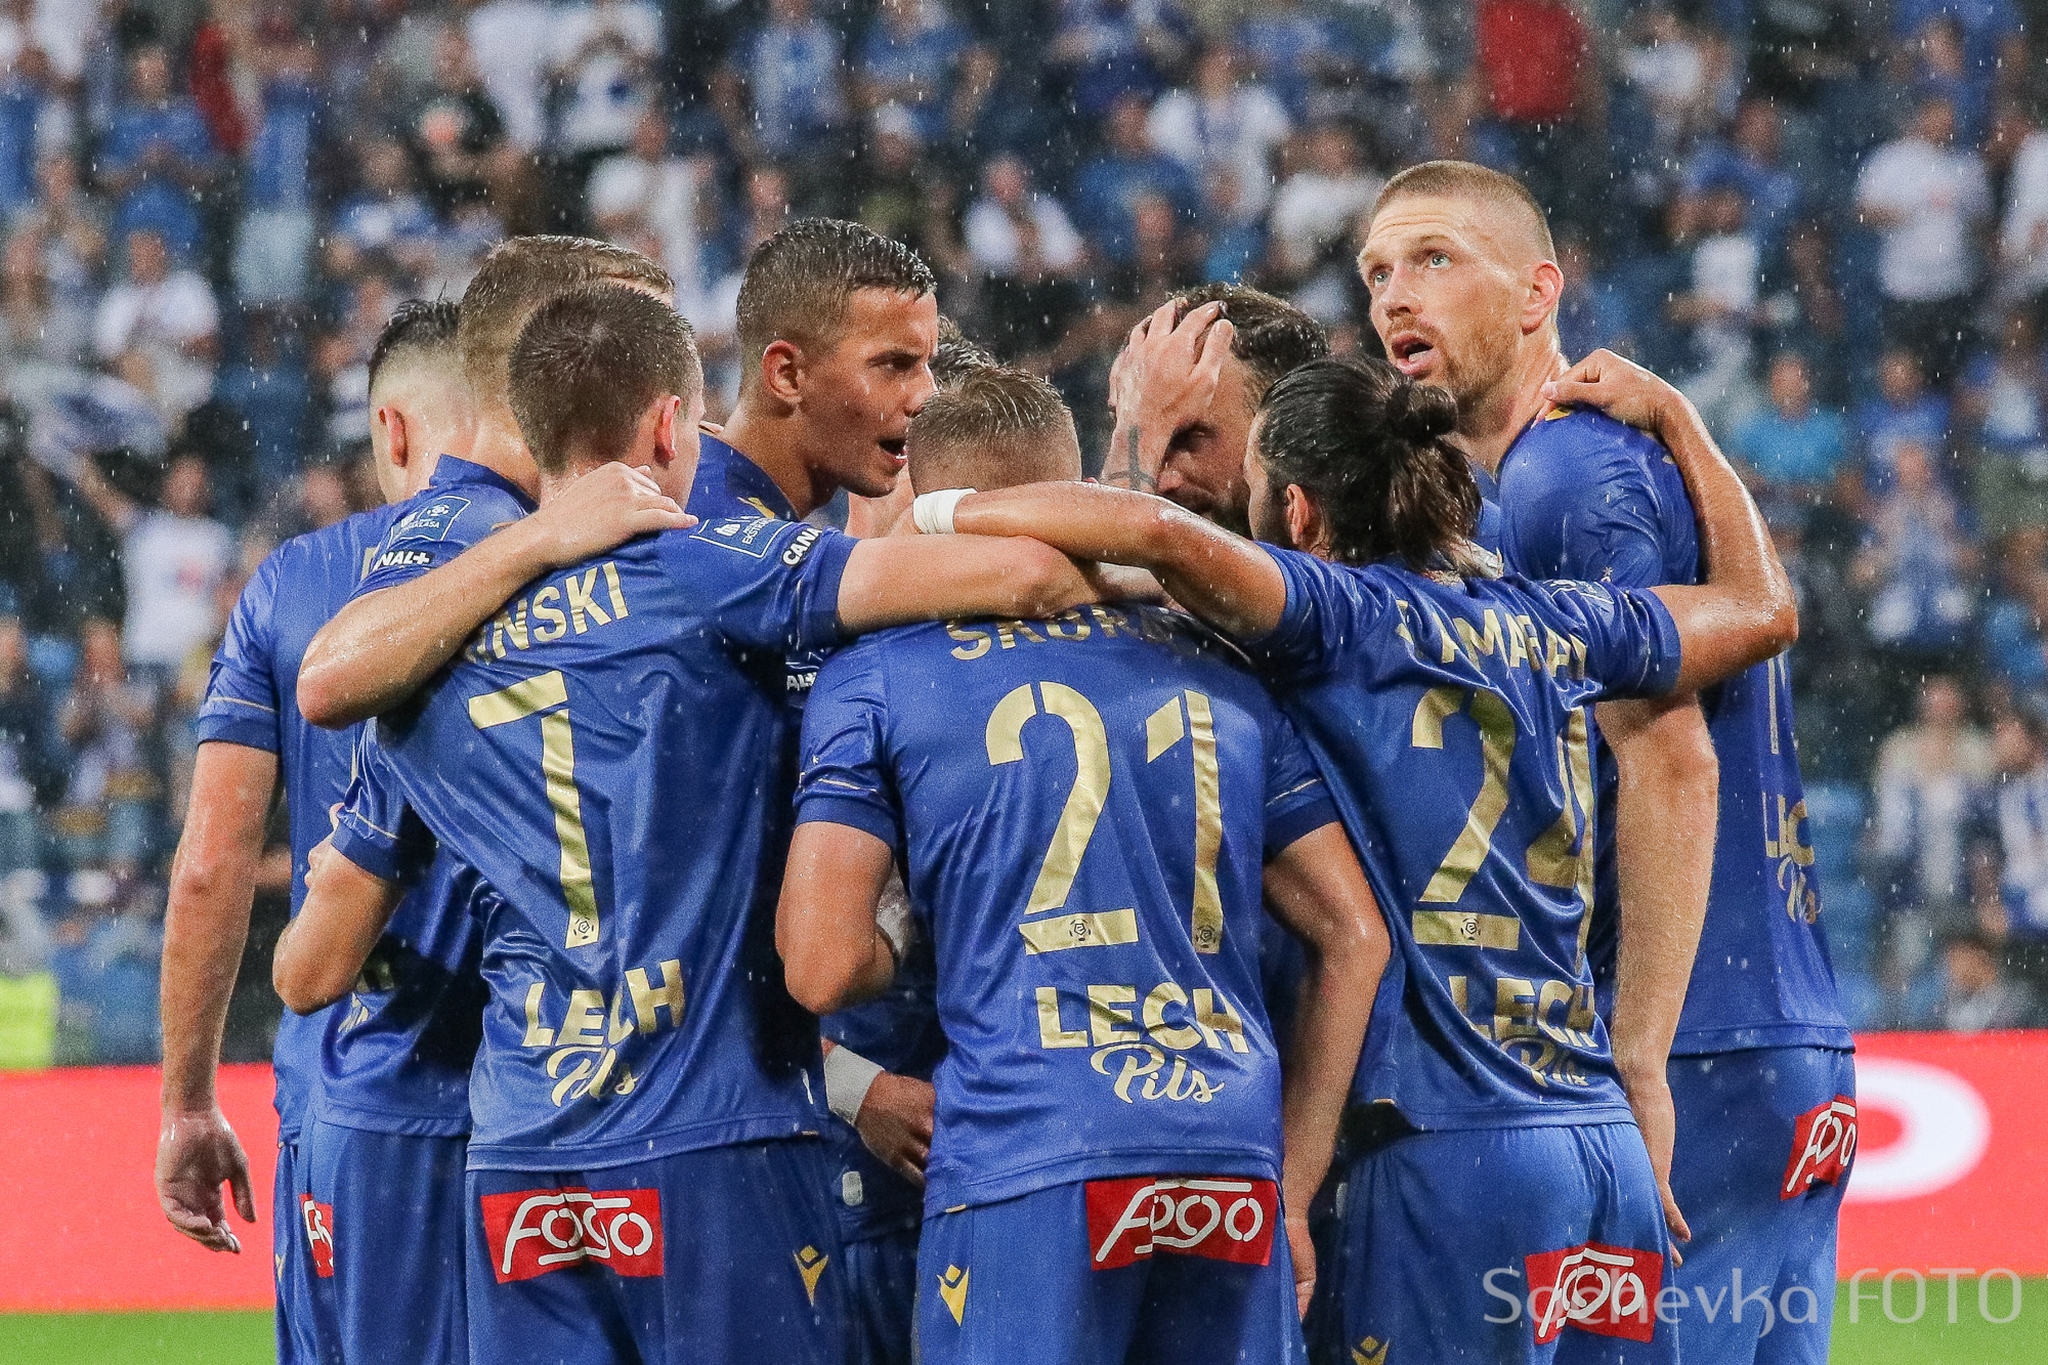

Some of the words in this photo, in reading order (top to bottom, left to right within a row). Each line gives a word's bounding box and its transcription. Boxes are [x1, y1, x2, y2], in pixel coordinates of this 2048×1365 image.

[478, 561, 630, 667] NSKI
[468, 669, 600, 949] 7
[985, 681, 1225, 955] 21
[1412, 685, 1595, 976] 24
[521, 959, 686, 1047] LECH
[1035, 981, 1250, 1054] LECH
[1448, 976, 1598, 1048] LECH
[1090, 1043, 1225, 1104] Pils
